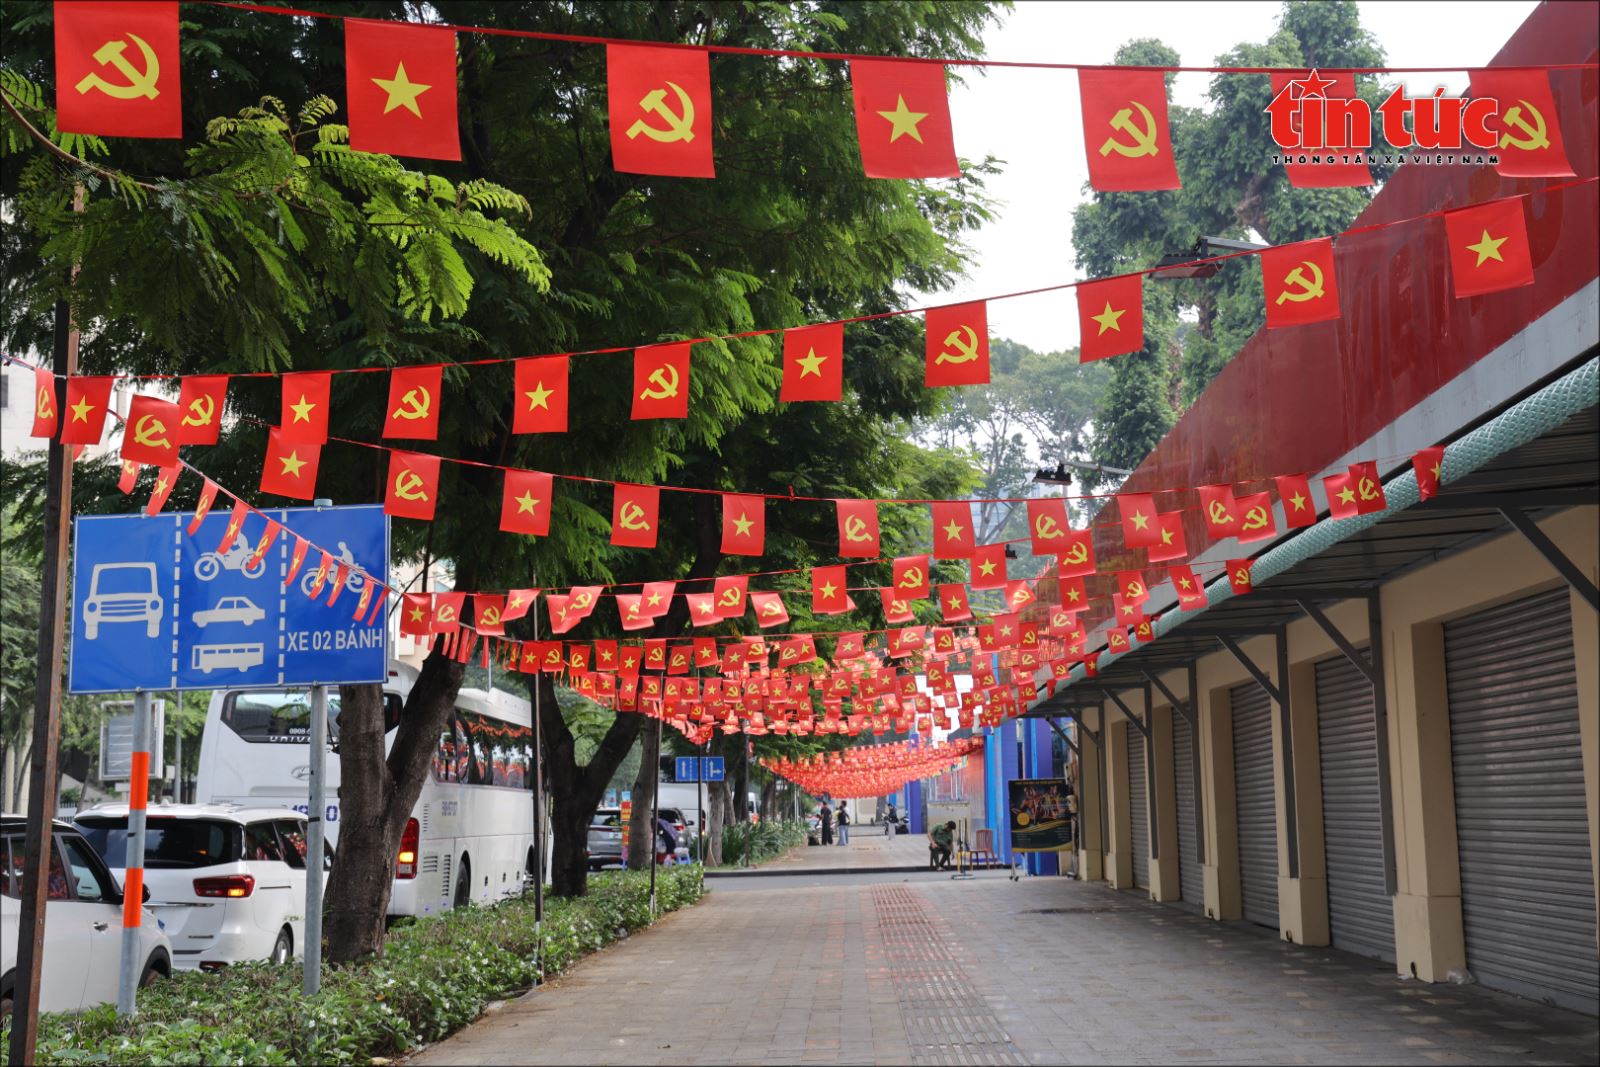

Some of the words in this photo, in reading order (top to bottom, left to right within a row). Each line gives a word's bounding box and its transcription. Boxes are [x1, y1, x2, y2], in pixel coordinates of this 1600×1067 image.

[287, 631, 309, 652] XE
[312, 630, 332, 650] 02
[335, 622, 383, 650] BÁNH
